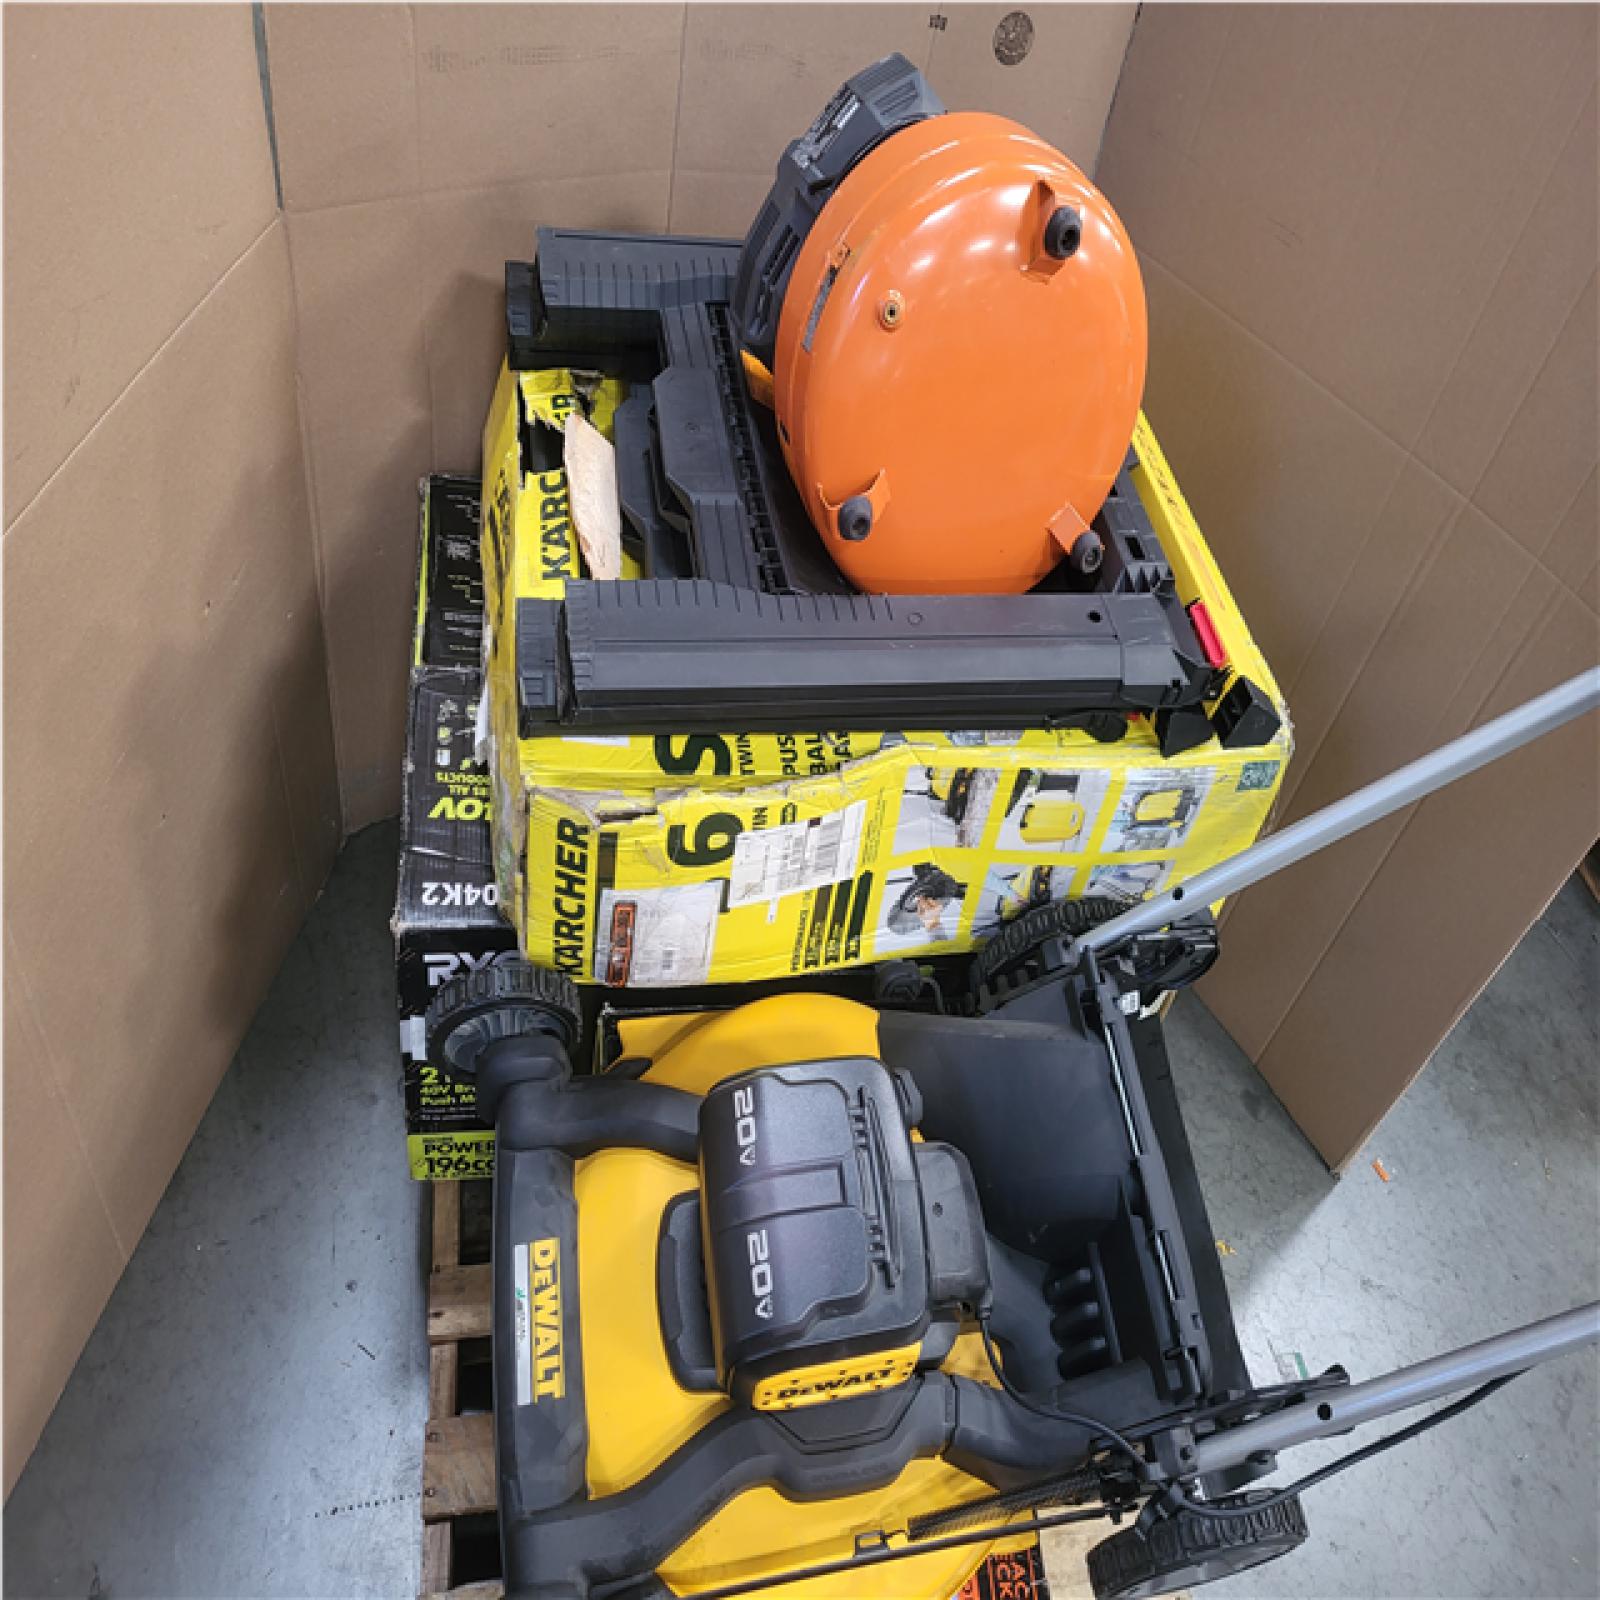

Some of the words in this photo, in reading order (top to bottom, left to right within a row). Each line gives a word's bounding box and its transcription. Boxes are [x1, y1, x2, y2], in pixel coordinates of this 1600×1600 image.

[667, 812, 743, 867] 6
[734, 1088, 756, 1166] 20V
[747, 1229, 774, 1320] 20V
